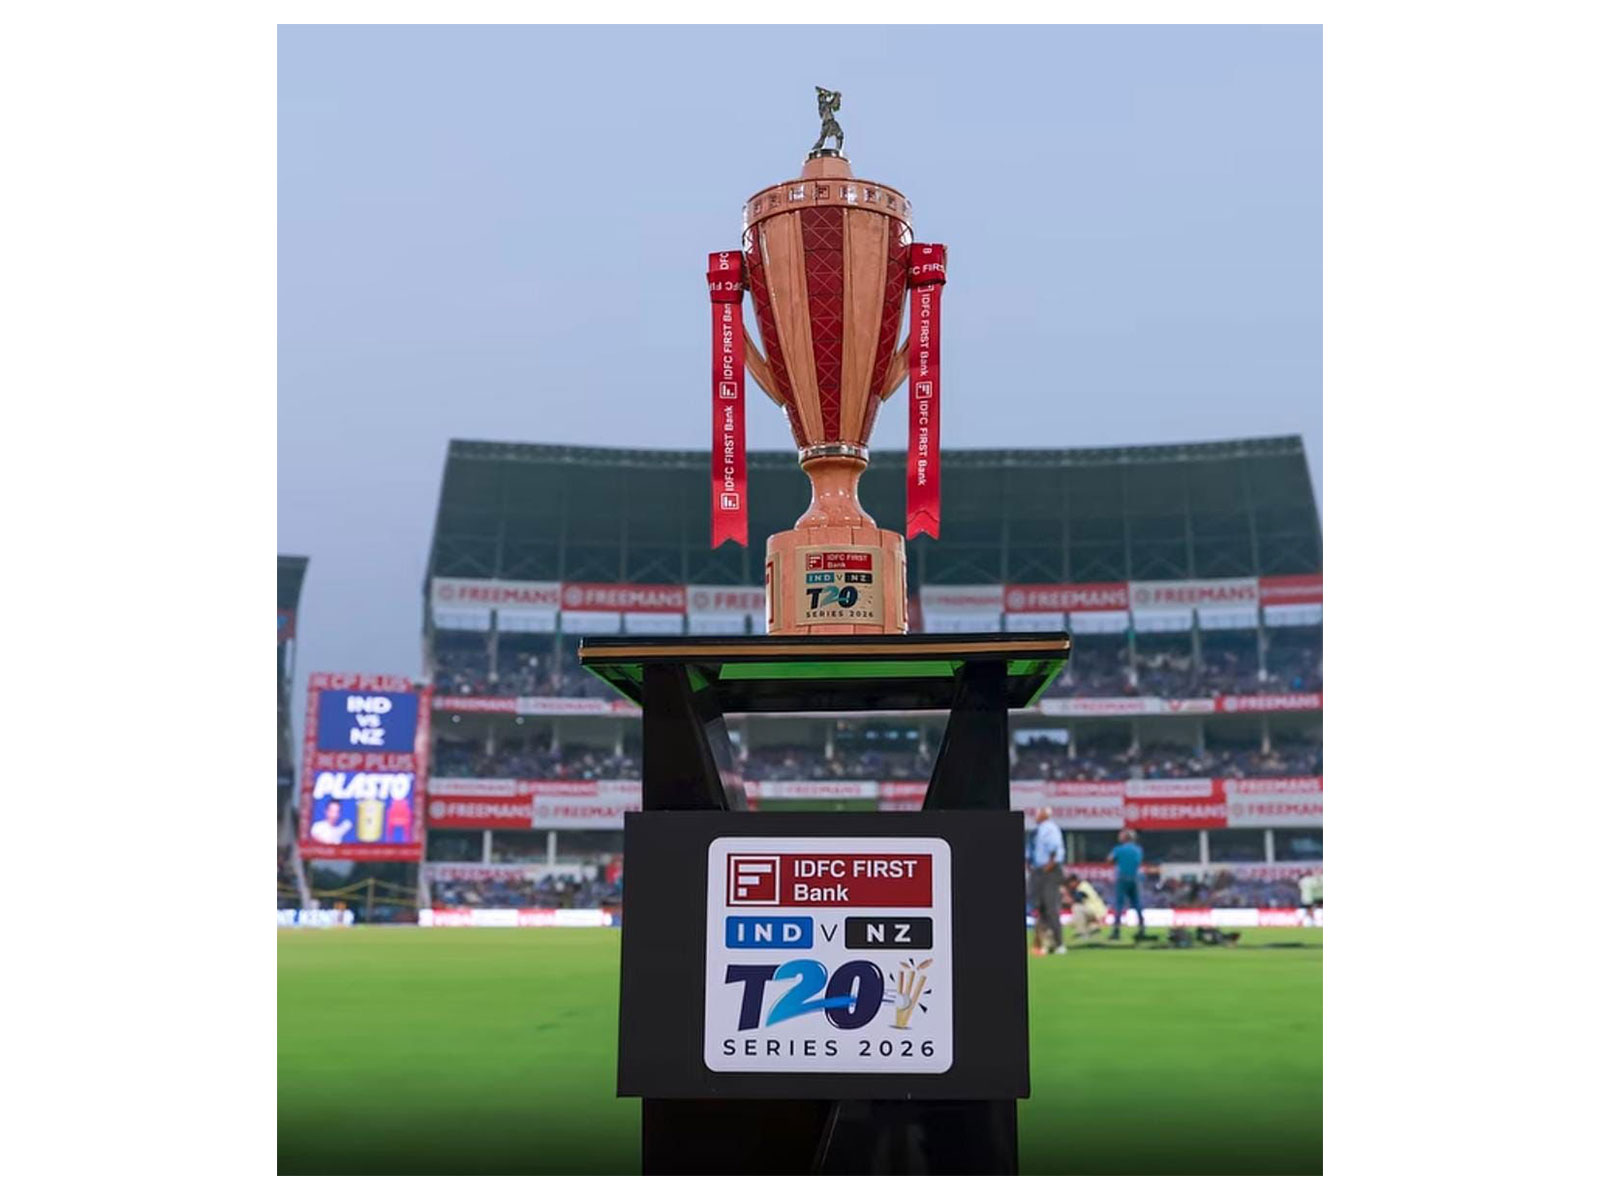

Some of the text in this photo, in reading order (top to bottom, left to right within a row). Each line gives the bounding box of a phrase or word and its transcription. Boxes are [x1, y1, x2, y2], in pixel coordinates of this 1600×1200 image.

[723, 323, 733, 354] FIRST
[919, 293, 931, 377] IDFC FIRST Bank
[723, 355, 733, 380] IDFC
[723, 405, 735, 492] IDFC FIRST Bank
[917, 400, 929, 486] IDFC FIRST Bank
[826, 554, 868, 562] IDFC FIRST
[827, 561, 846, 569] Bank
[808, 574, 832, 582] IND
[850, 574, 867, 582] NZ
[806, 585, 858, 610] T20
[1028, 588, 1127, 608] FREEMANS
[1154, 585, 1255, 604] FREEMANS
[806, 610, 874, 618] SERIES 2026
[347, 695, 393, 714] IND
[350, 727, 385, 746] NZ
[313, 772, 411, 800] PLASTO
[793, 859, 917, 879] IDFC FIRST
[793, 883, 849, 902] Bank
[737, 923, 803, 943] IND
[866, 923, 911, 943] NZ
[725, 958, 885, 1031] T20
[722, 1039, 935, 1058] SERIES 2026
